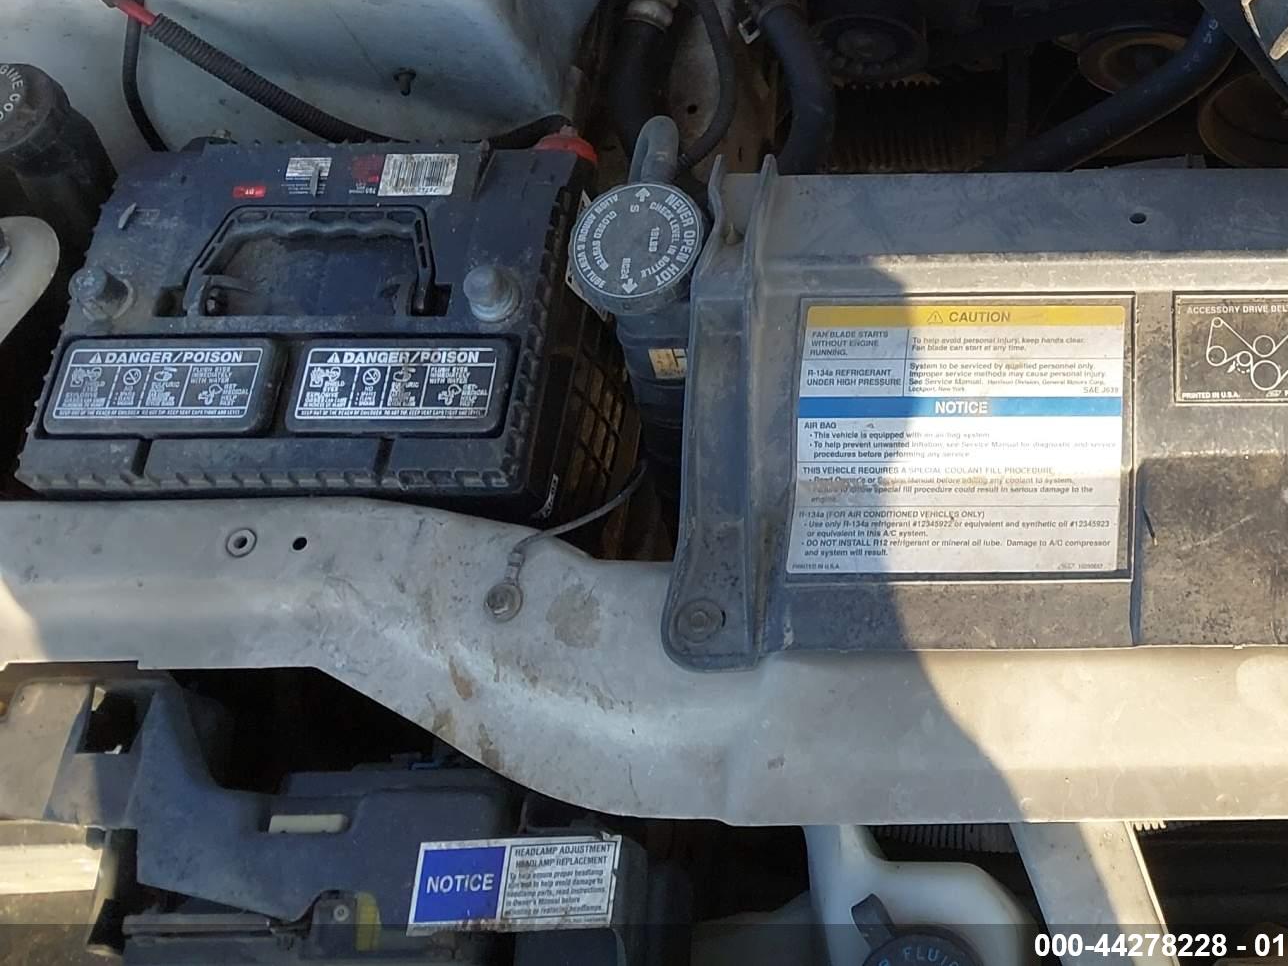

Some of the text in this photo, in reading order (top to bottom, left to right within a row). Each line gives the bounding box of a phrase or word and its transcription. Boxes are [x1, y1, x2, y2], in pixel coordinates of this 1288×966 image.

[594, 193, 618, 214] ALIGN
[578, 214, 596, 243] ARROW
[592, 211, 617, 271] CLOSED SYSTEM
[640, 202, 681, 278] CHECK LEVEL IN BOTTLE
[656, 193, 696, 286] NEVER OPEN HOT
[578, 252, 590, 271] VENT
[586, 269, 606, 289] TUBE
[1187, 306, 1240, 314] ACCESSORY
[1242, 305, 1268, 314] DRIVE
[949, 311, 1011, 323] CAUTION
[104, 351, 243, 364] DANGER/POISON
[343, 351, 480, 364] DANGER/POISON
[807, 378, 902, 386] UNDER HIGH PRESSURE
[935, 401, 988, 414] NOTICE
[869, 432, 904, 440] equipped
[824, 442, 841, 450] help
[842, 442, 872, 450] prevent
[961, 511, 985, 519] ONLY)
[890, 540, 930, 548] refrigerant
[1006, 540, 1037, 548] Damage
[1065, 540, 1110, 548] compressor
[820, 549, 848, 558] system
[515, 844, 612, 856] HEADLAMP ADJUSTMENT
[516, 856, 608, 868] HEADLAMP REPLACEMENT
[426, 874, 494, 894] NOTICE
